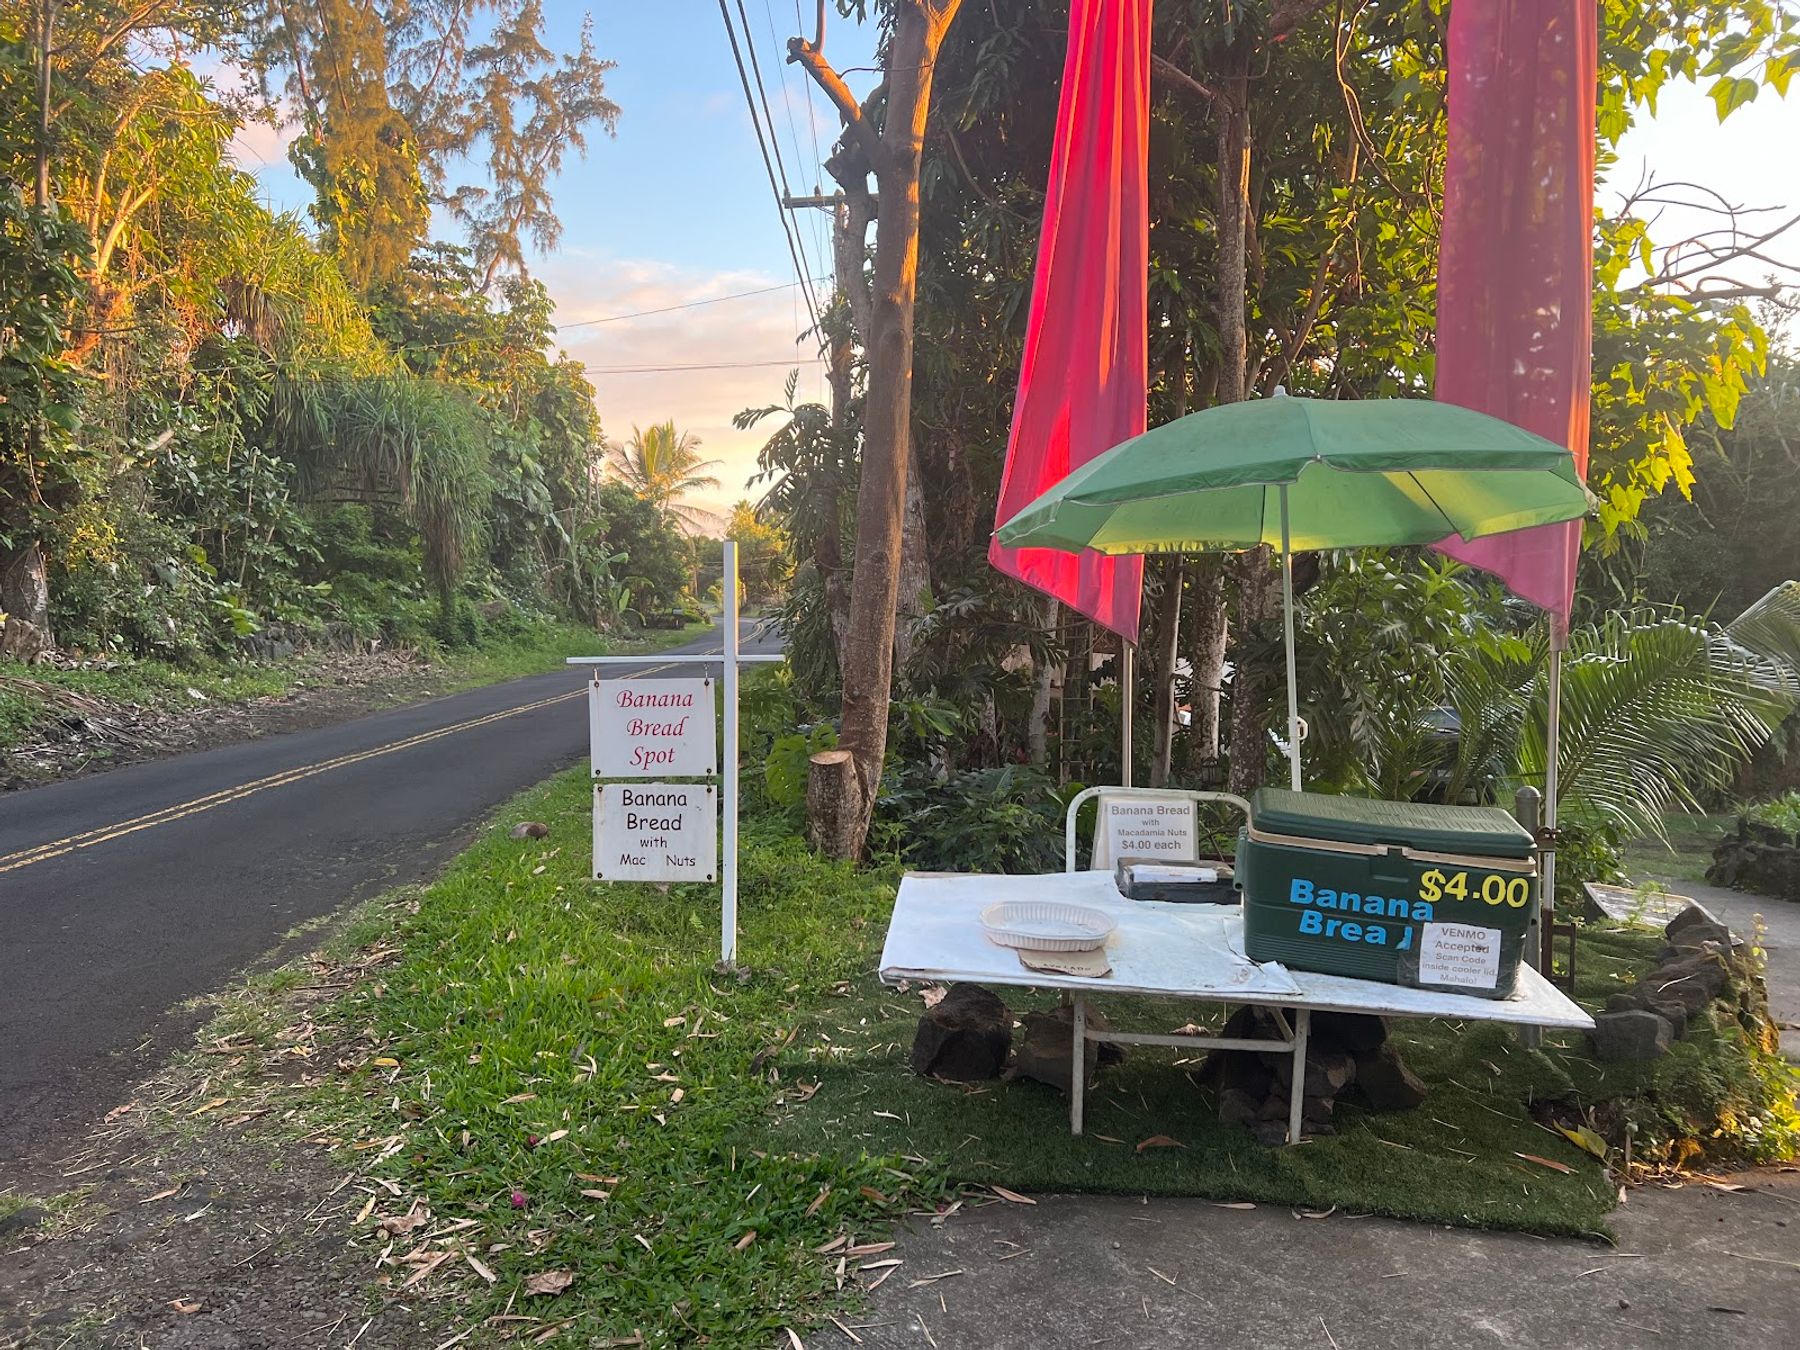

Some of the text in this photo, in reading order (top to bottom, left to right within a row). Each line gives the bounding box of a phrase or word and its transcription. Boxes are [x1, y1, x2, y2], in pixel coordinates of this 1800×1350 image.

[616, 689, 694, 708] Banana
[626, 716, 690, 736] Bread
[629, 746, 675, 770] Spot
[622, 789, 687, 806] Banana
[1111, 805, 1190, 816] Banana Bread
[627, 813, 682, 831] Bread
[1117, 829, 1187, 837] Macadamia Nuts
[640, 836, 668, 848] with
[1122, 840, 1181, 850] $4.00 each
[619, 854, 696, 867] Mac Nuts
[1419, 868, 1529, 908] $4.00
[1290, 878, 1434, 922] Banana
[1442, 927, 1486, 940] VENMO
[1435, 940, 1490, 954] Accepted
[1435, 952, 1487, 964] Scan Code
[1422, 962, 1449, 971] inside
[1452, 965, 1482, 974] cooler
